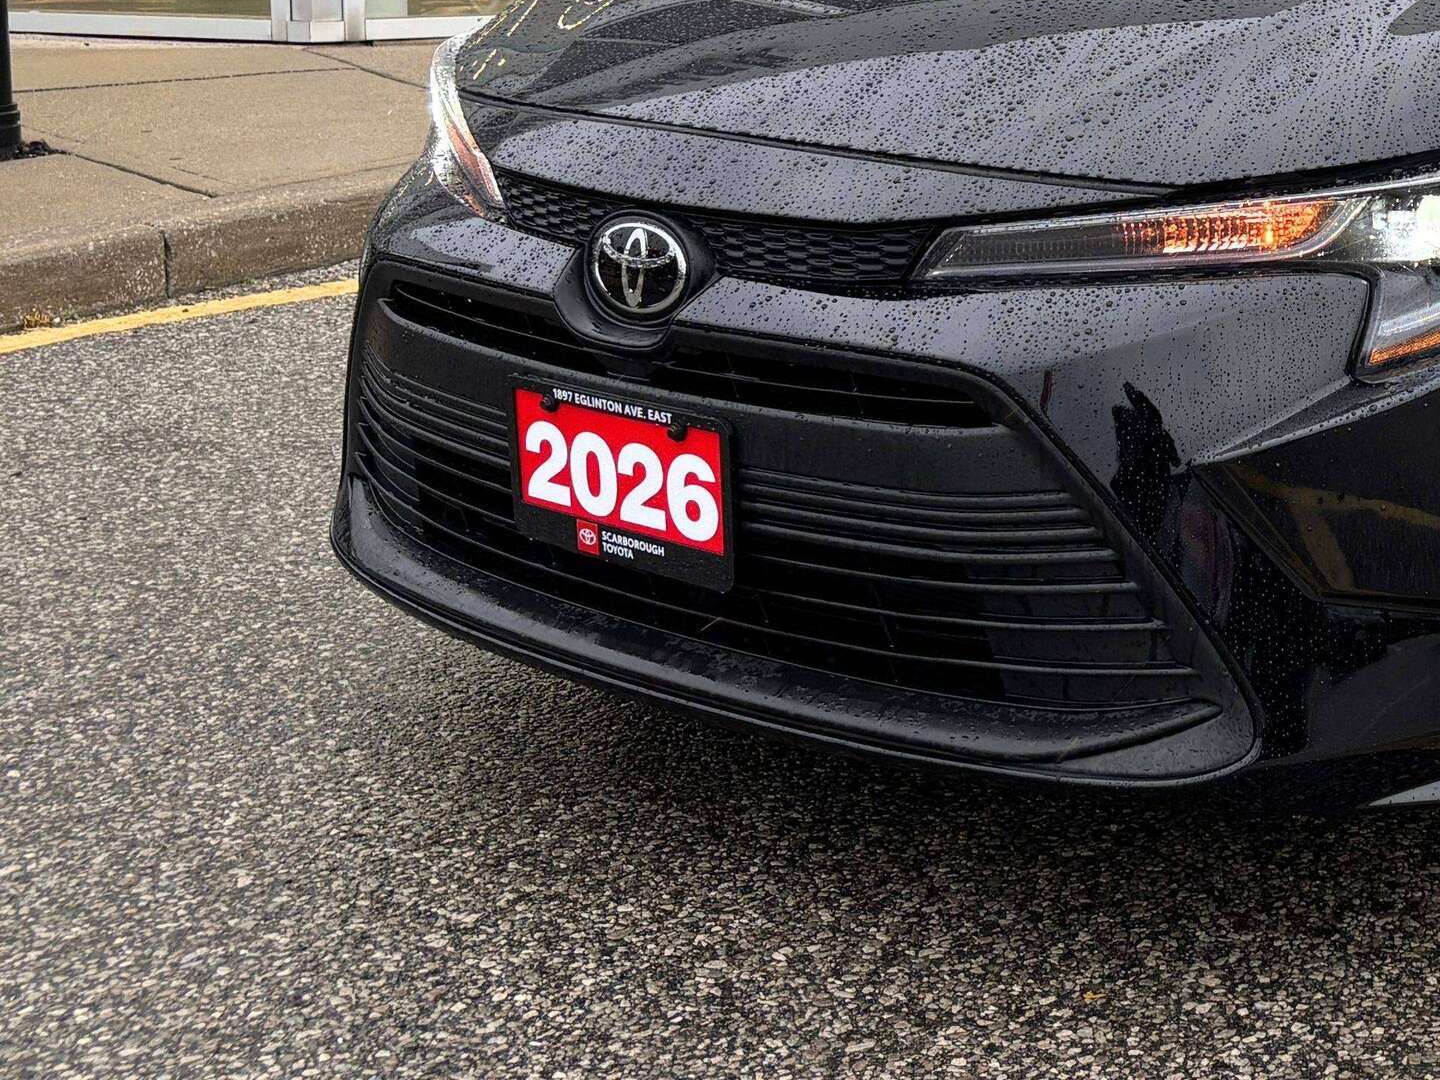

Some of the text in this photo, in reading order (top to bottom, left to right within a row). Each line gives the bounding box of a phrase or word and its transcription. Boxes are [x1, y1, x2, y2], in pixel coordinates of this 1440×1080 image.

[552, 388, 673, 424] 1897 EGLINTON AVE. EAST
[525, 421, 719, 542] 2026
[601, 531, 665, 557] SCARBOROUGH
[602, 542, 634, 560] TOYOTA
